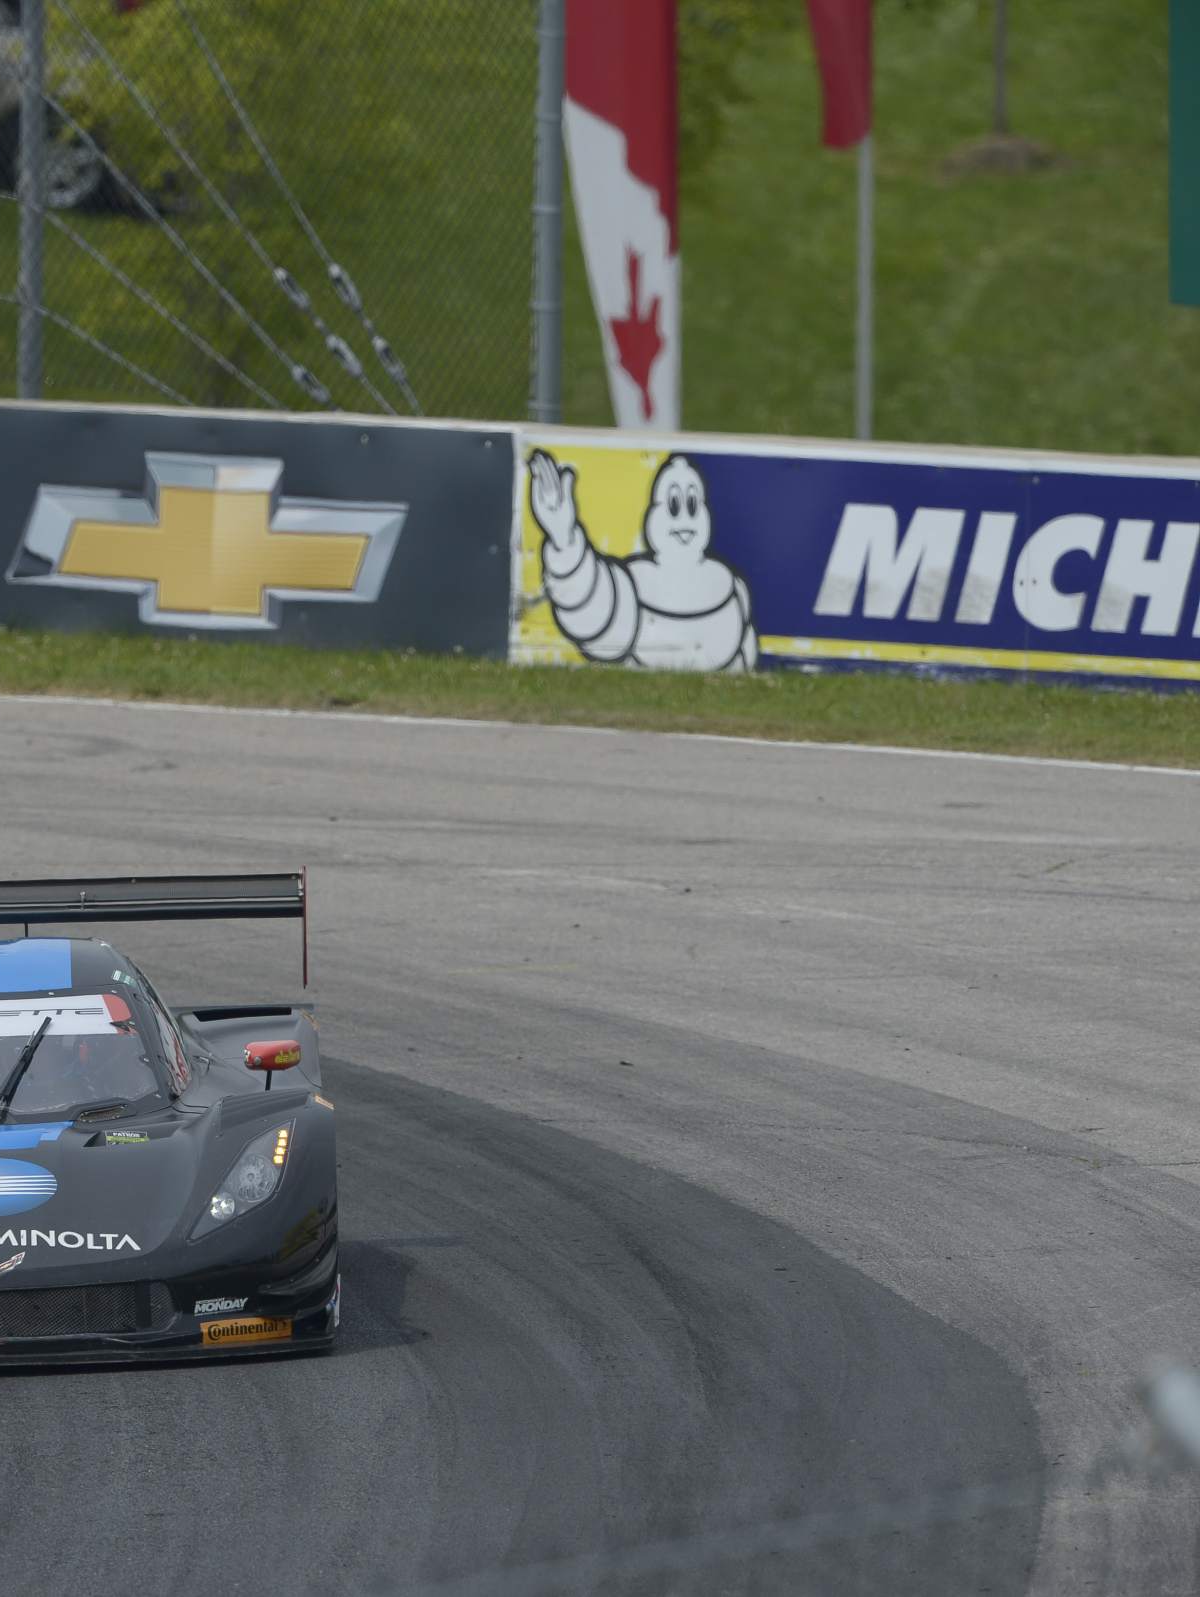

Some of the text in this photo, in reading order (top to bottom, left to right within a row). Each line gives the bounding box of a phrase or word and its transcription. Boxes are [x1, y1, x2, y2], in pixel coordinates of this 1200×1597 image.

[813, 502, 1200, 638] MICH
[194, 1297, 248, 1314] MONDAY
[207, 1319, 279, 1341] Continental
